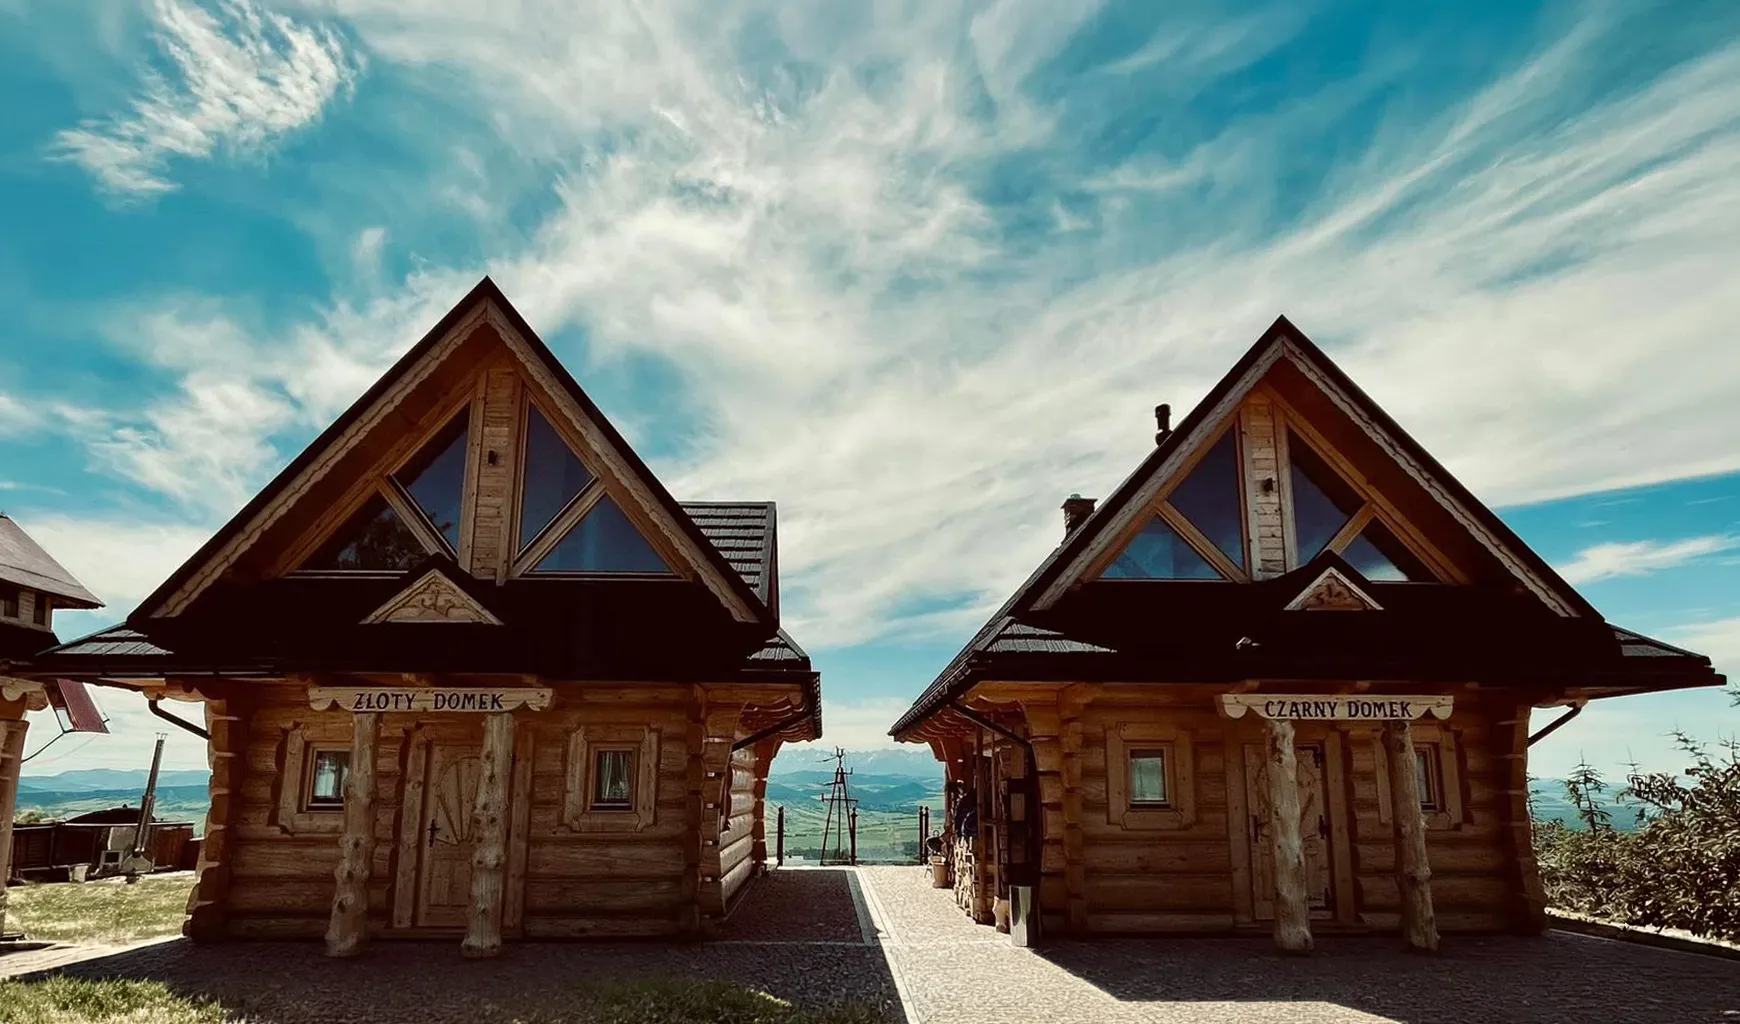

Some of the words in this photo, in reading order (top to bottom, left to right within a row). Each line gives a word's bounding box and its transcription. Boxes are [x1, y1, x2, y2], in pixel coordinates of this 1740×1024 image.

[433, 692, 504, 710] DOMEK
[1265, 700, 1338, 718] CZARNY
[1348, 700, 1413, 718] DOMEK
